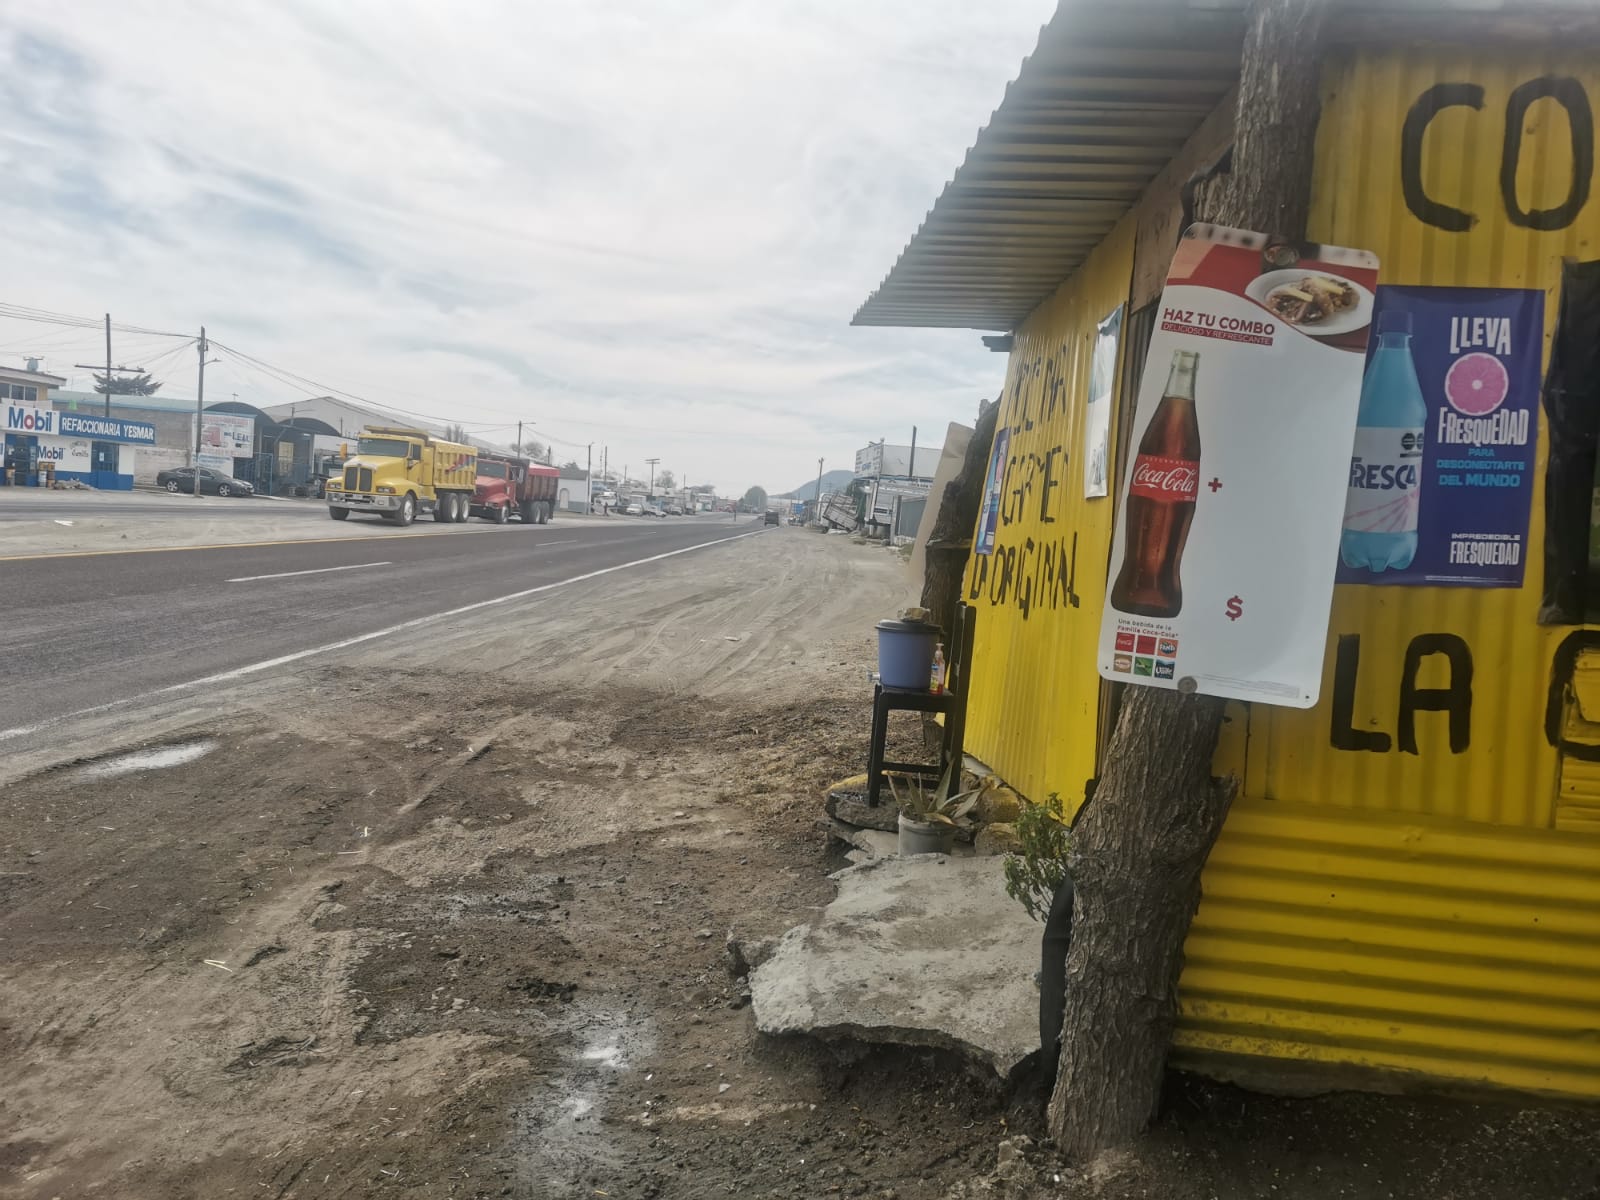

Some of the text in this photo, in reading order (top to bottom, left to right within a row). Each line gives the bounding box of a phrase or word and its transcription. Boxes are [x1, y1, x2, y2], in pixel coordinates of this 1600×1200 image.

[1163, 308, 1275, 335] HAZ TU COMBO
[1163, 323, 1205, 336] DELICIOSO
[1450, 317, 1511, 355] LLEVA
[9, 406, 53, 432] Mobil
[62, 417, 154, 440] REFACCIONARIA YESMAR
[1437, 407, 1529, 447] FRESQUEDAD
[38, 445, 63, 460] Mobil
[1436, 459, 1525, 470] DESCONECTARTE
[1468, 448, 1495, 457] PARA
[1133, 463, 1197, 492] Coca-Cola
[1439, 474, 1520, 487] DEL MUNDO
[1451, 533, 1520, 541] IMPREDECIBLE
[1449, 541, 1520, 566] FRESQUEDAD
[990, 531, 1080, 621] ORIGINAL
[1225, 595, 1244, 621] $
[1331, 633, 1474, 755] LA
